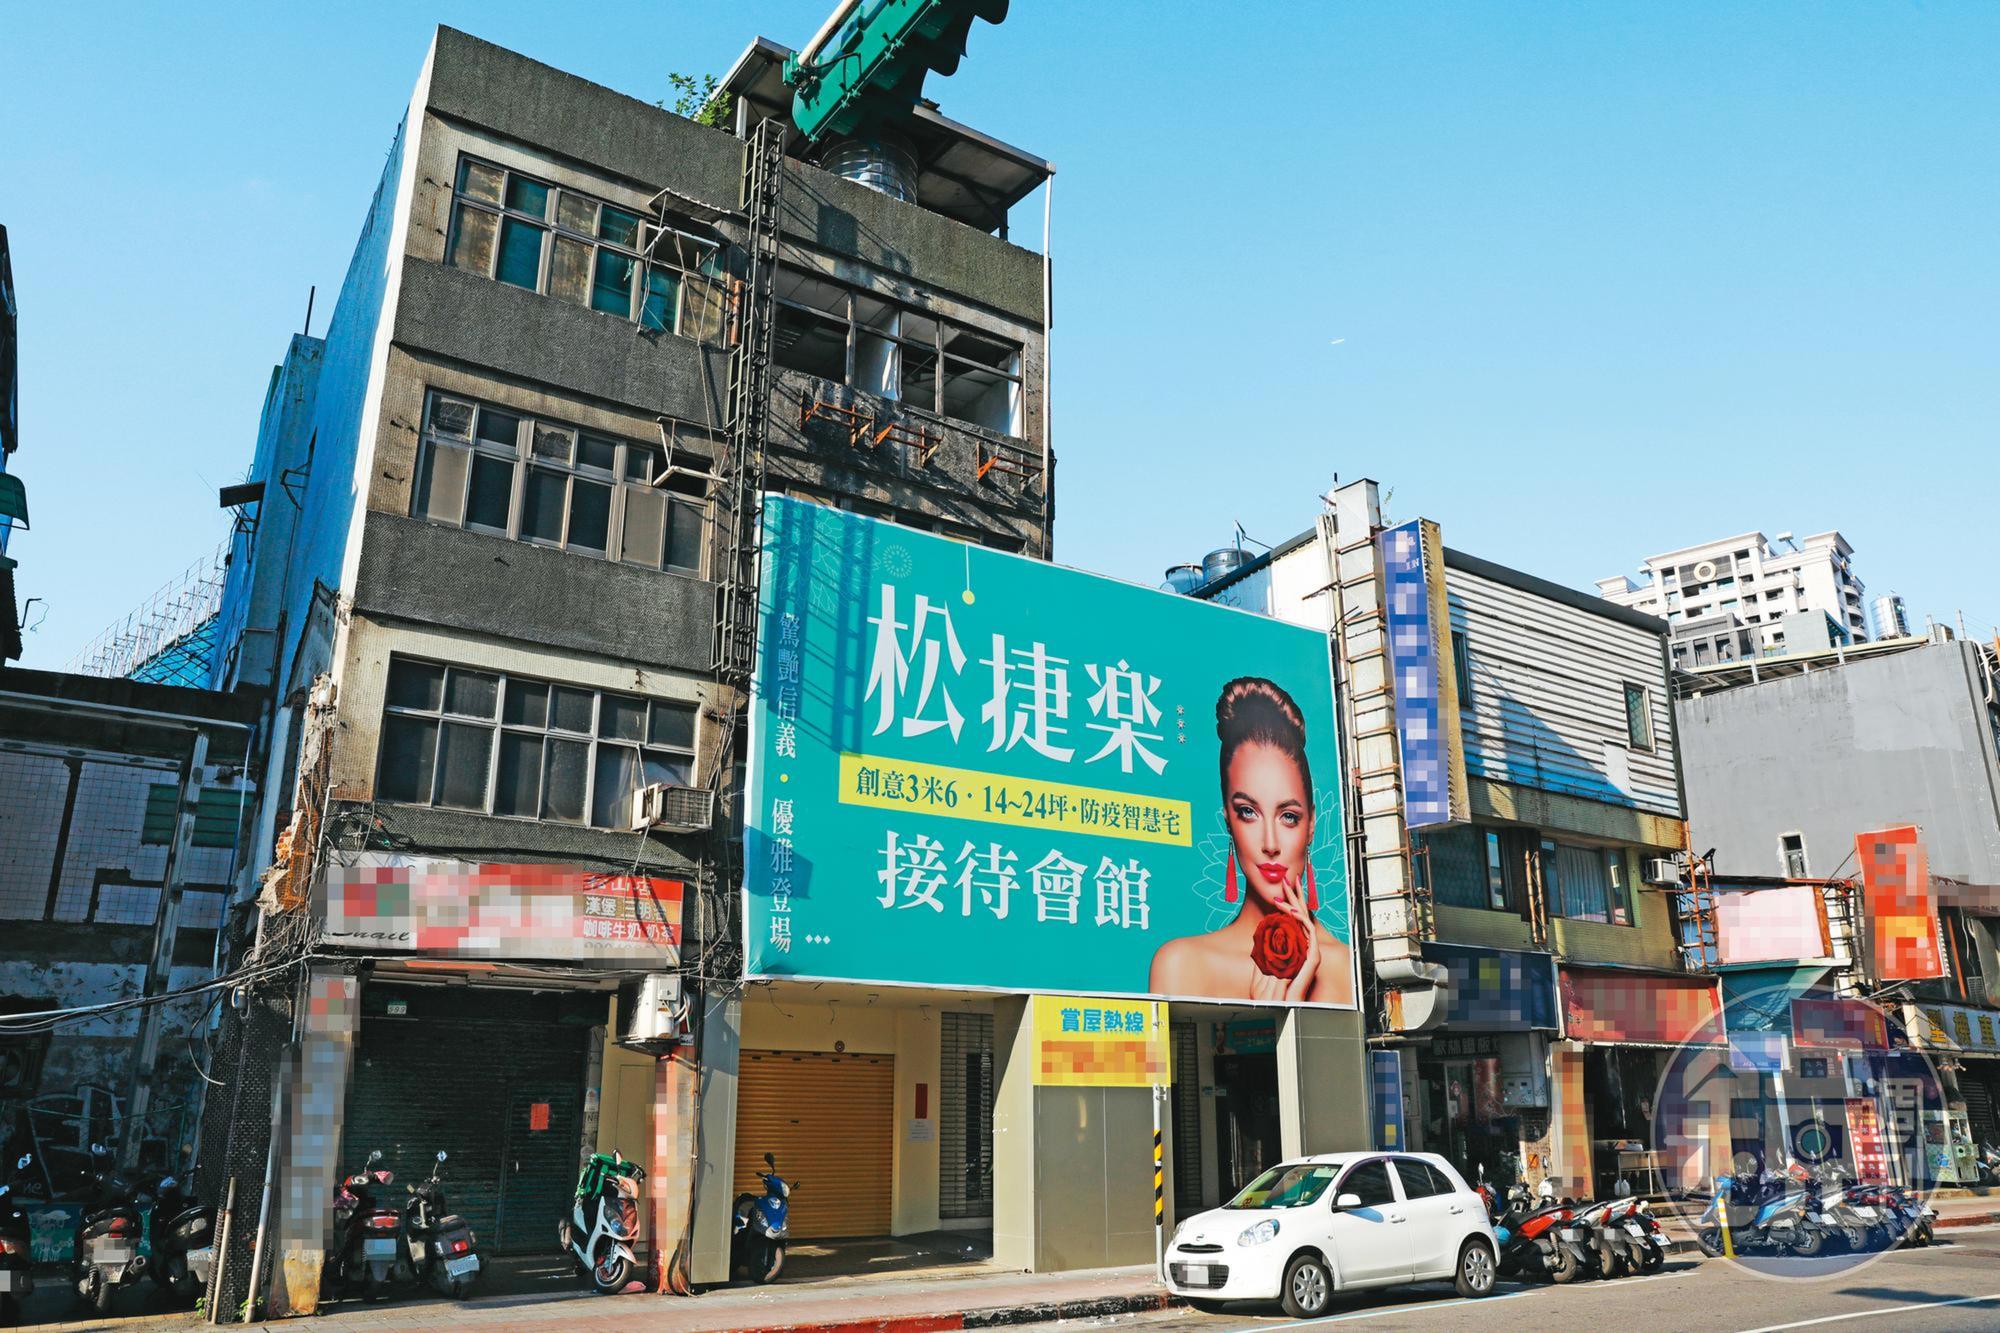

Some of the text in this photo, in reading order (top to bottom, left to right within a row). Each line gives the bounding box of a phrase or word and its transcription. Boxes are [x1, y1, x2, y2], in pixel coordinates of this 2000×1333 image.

[875, 829, 1152, 931] 接待會館
[1060, 1007, 1145, 1034] 賞屋熱線
